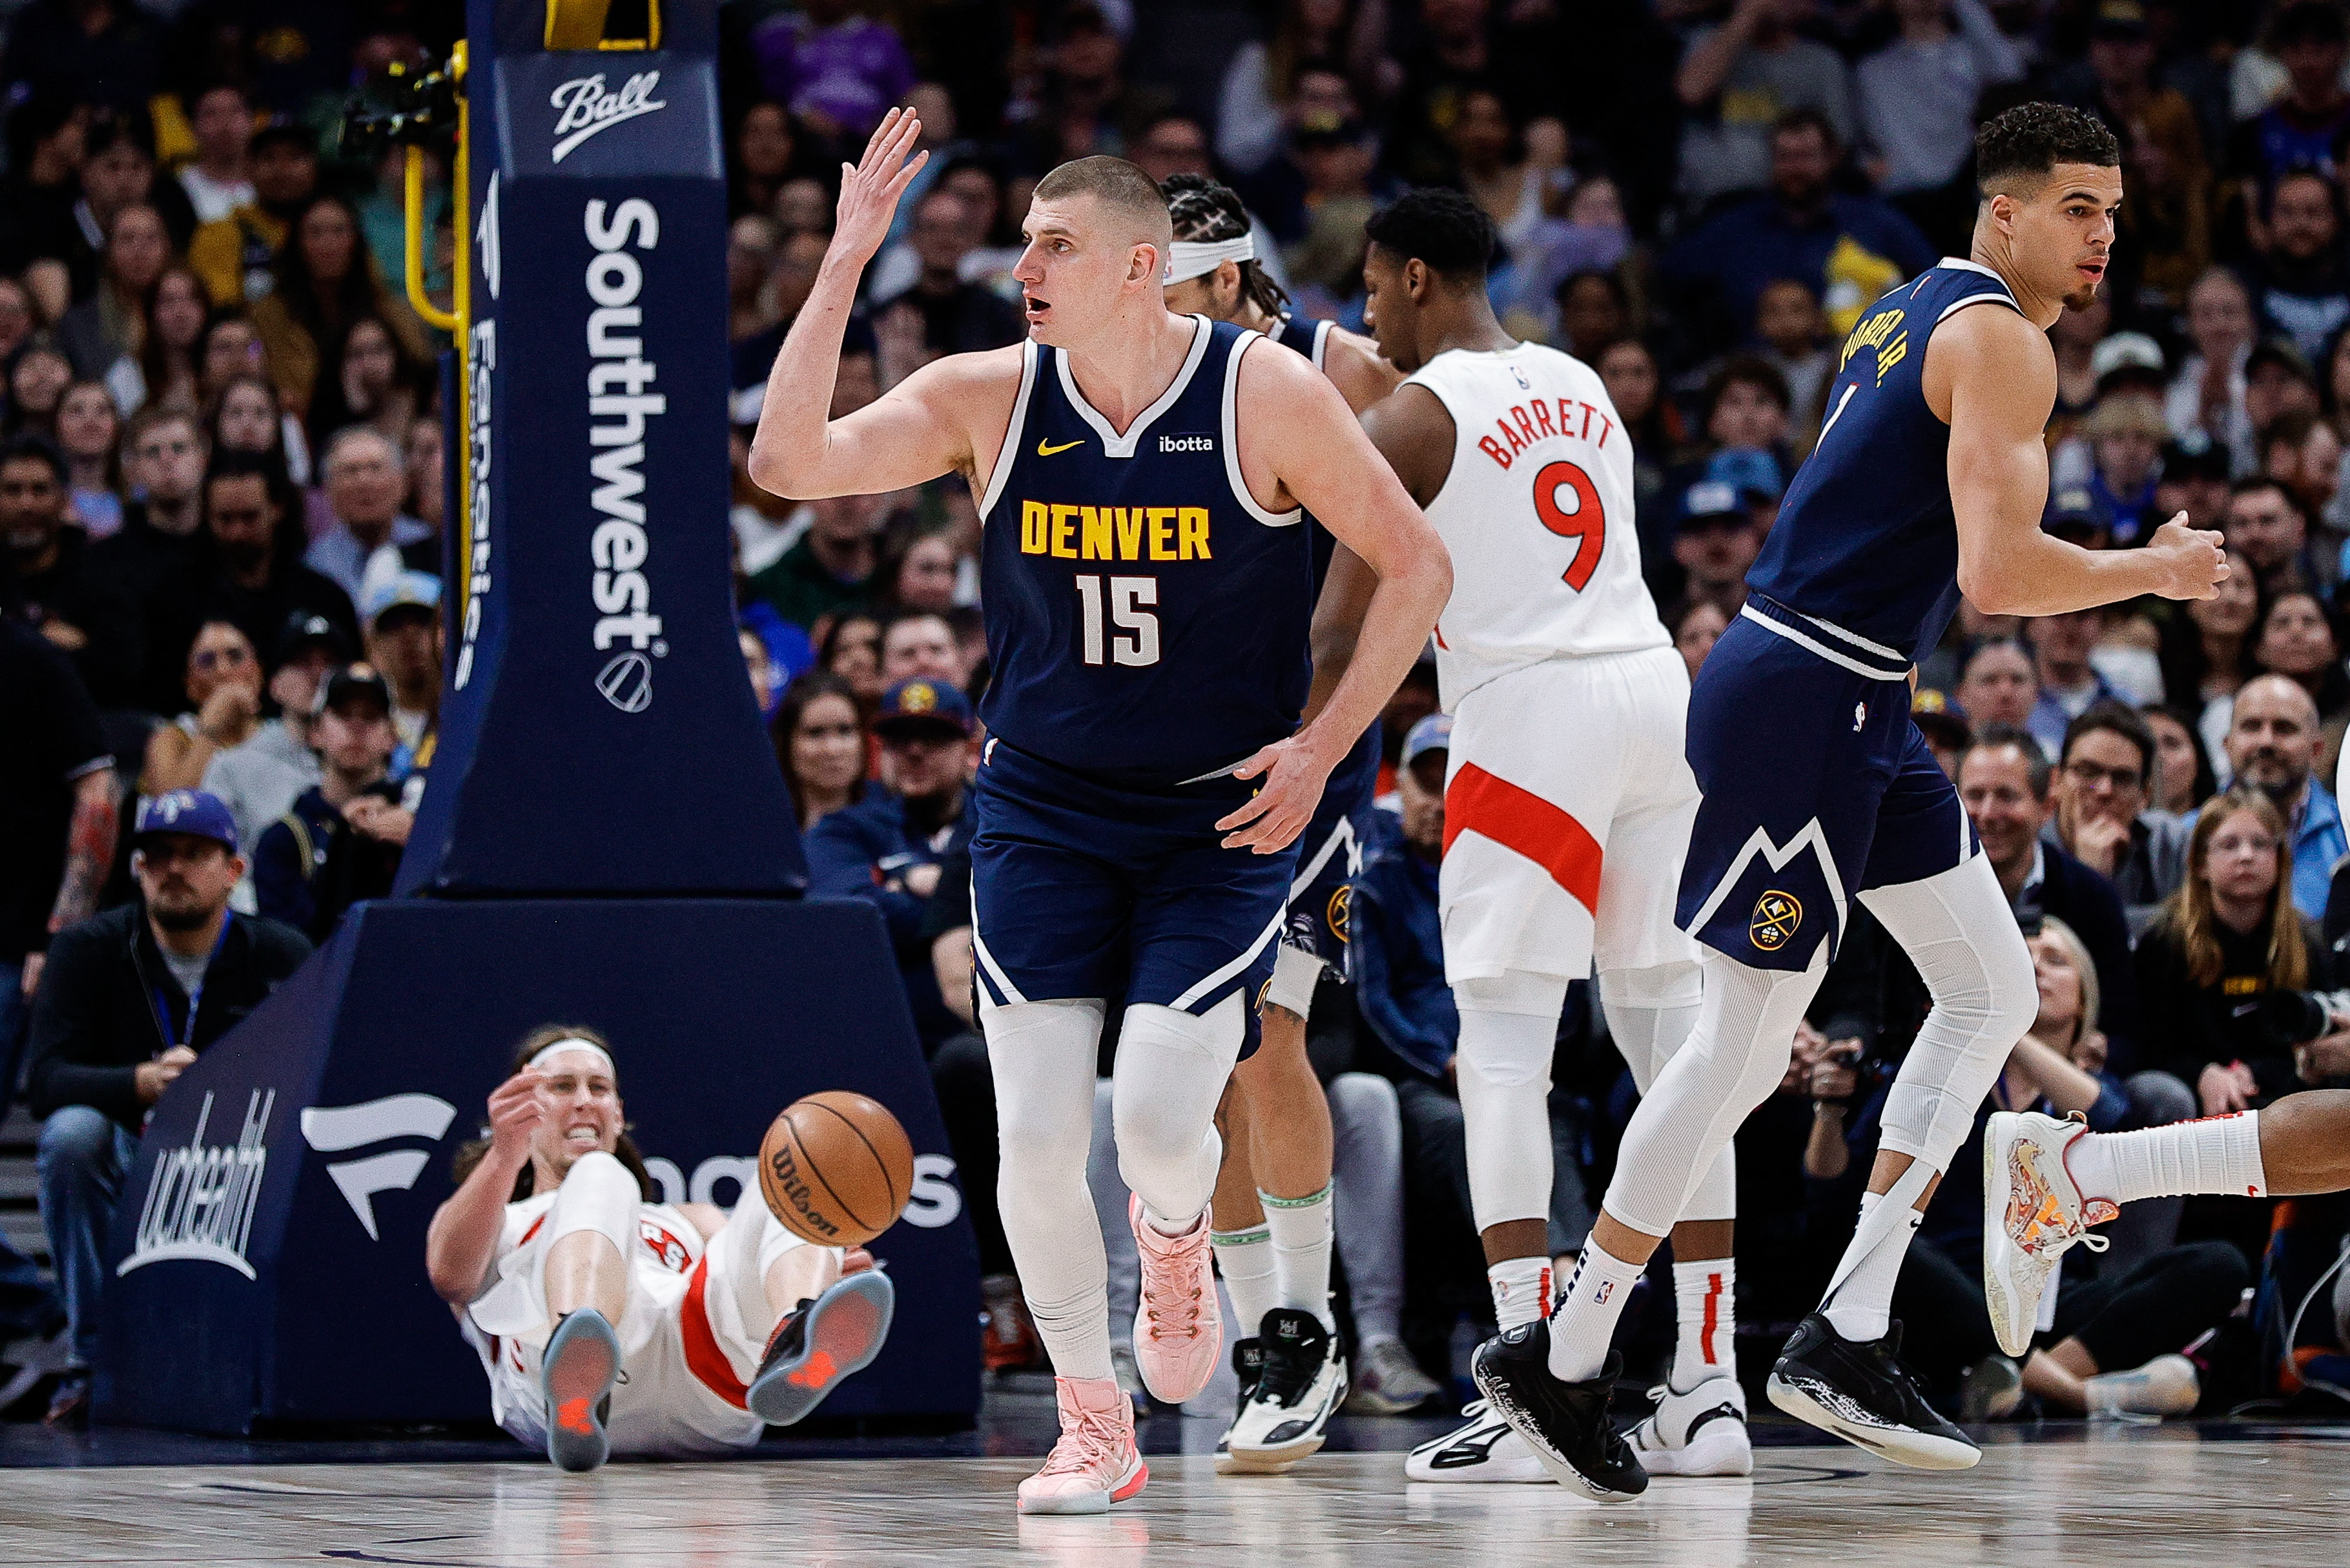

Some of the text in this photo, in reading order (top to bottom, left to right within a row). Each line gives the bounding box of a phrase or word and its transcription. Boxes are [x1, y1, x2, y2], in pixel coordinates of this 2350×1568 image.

[550, 70, 667, 163] Ball
[584, 198, 666, 650] Southwest
[1159, 435, 1213, 453] ibotta
[1478, 397, 1614, 471] BARRETT
[1020, 499, 1213, 562] DENVER
[1532, 460, 1605, 593] 9
[1075, 573, 1160, 666] 15
[772, 1143, 840, 1236] Wilson
